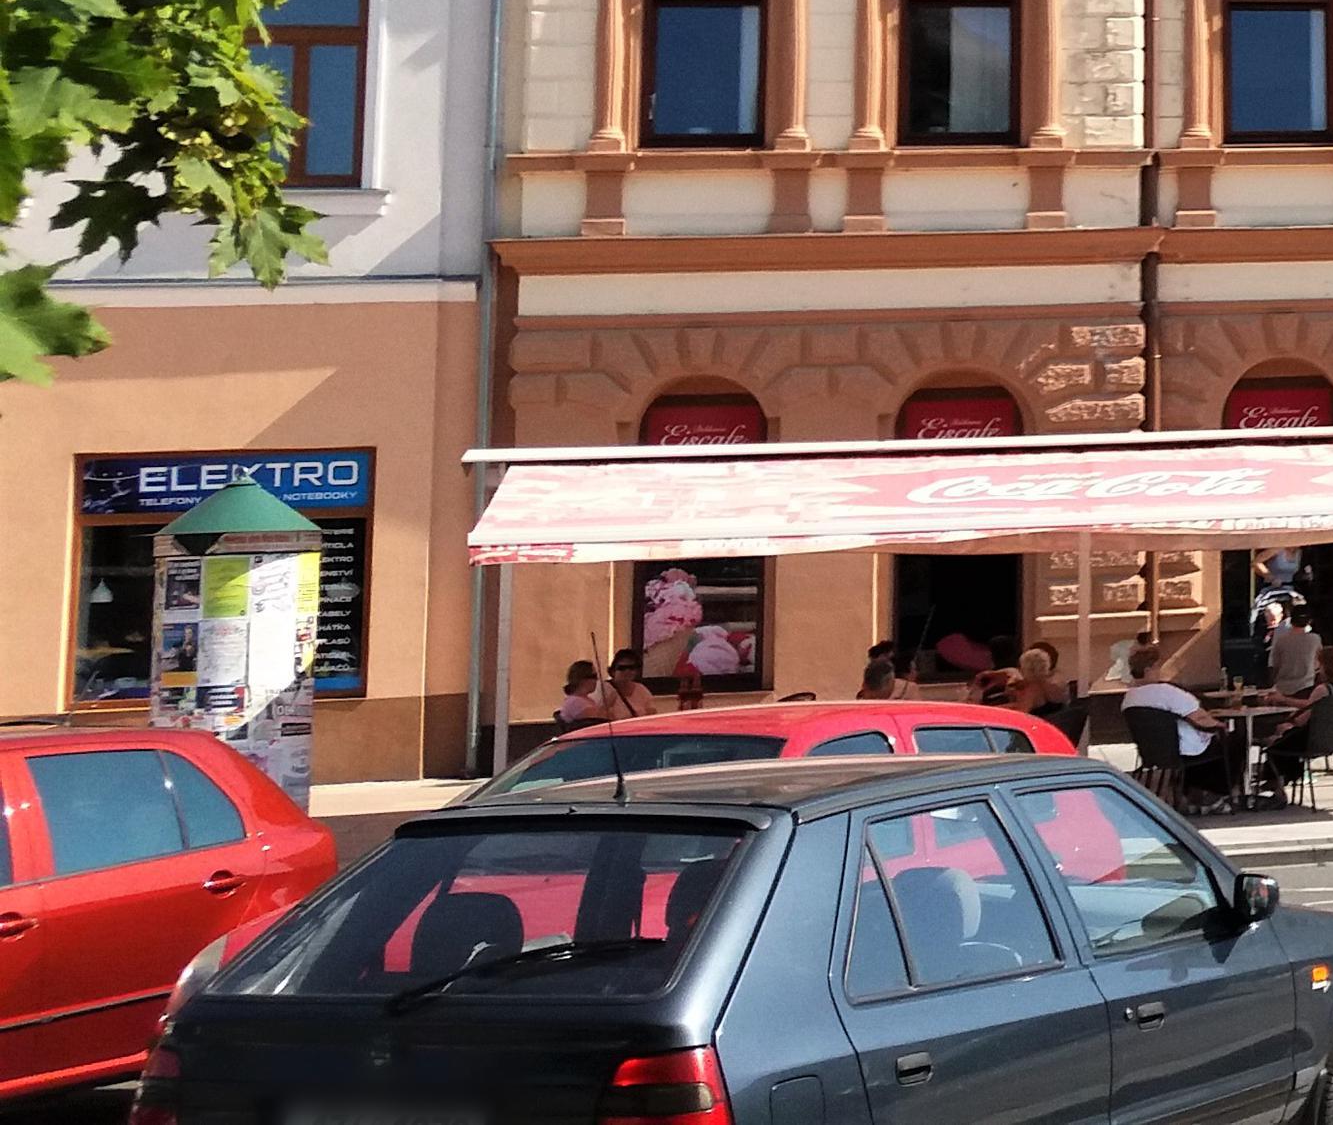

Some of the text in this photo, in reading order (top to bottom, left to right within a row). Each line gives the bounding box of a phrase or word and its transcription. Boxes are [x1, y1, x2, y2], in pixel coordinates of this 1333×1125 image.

[138, 460, 360, 493] ELEKTRO
[138, 490, 359, 507] TELEFONY NOTEBOOKY
